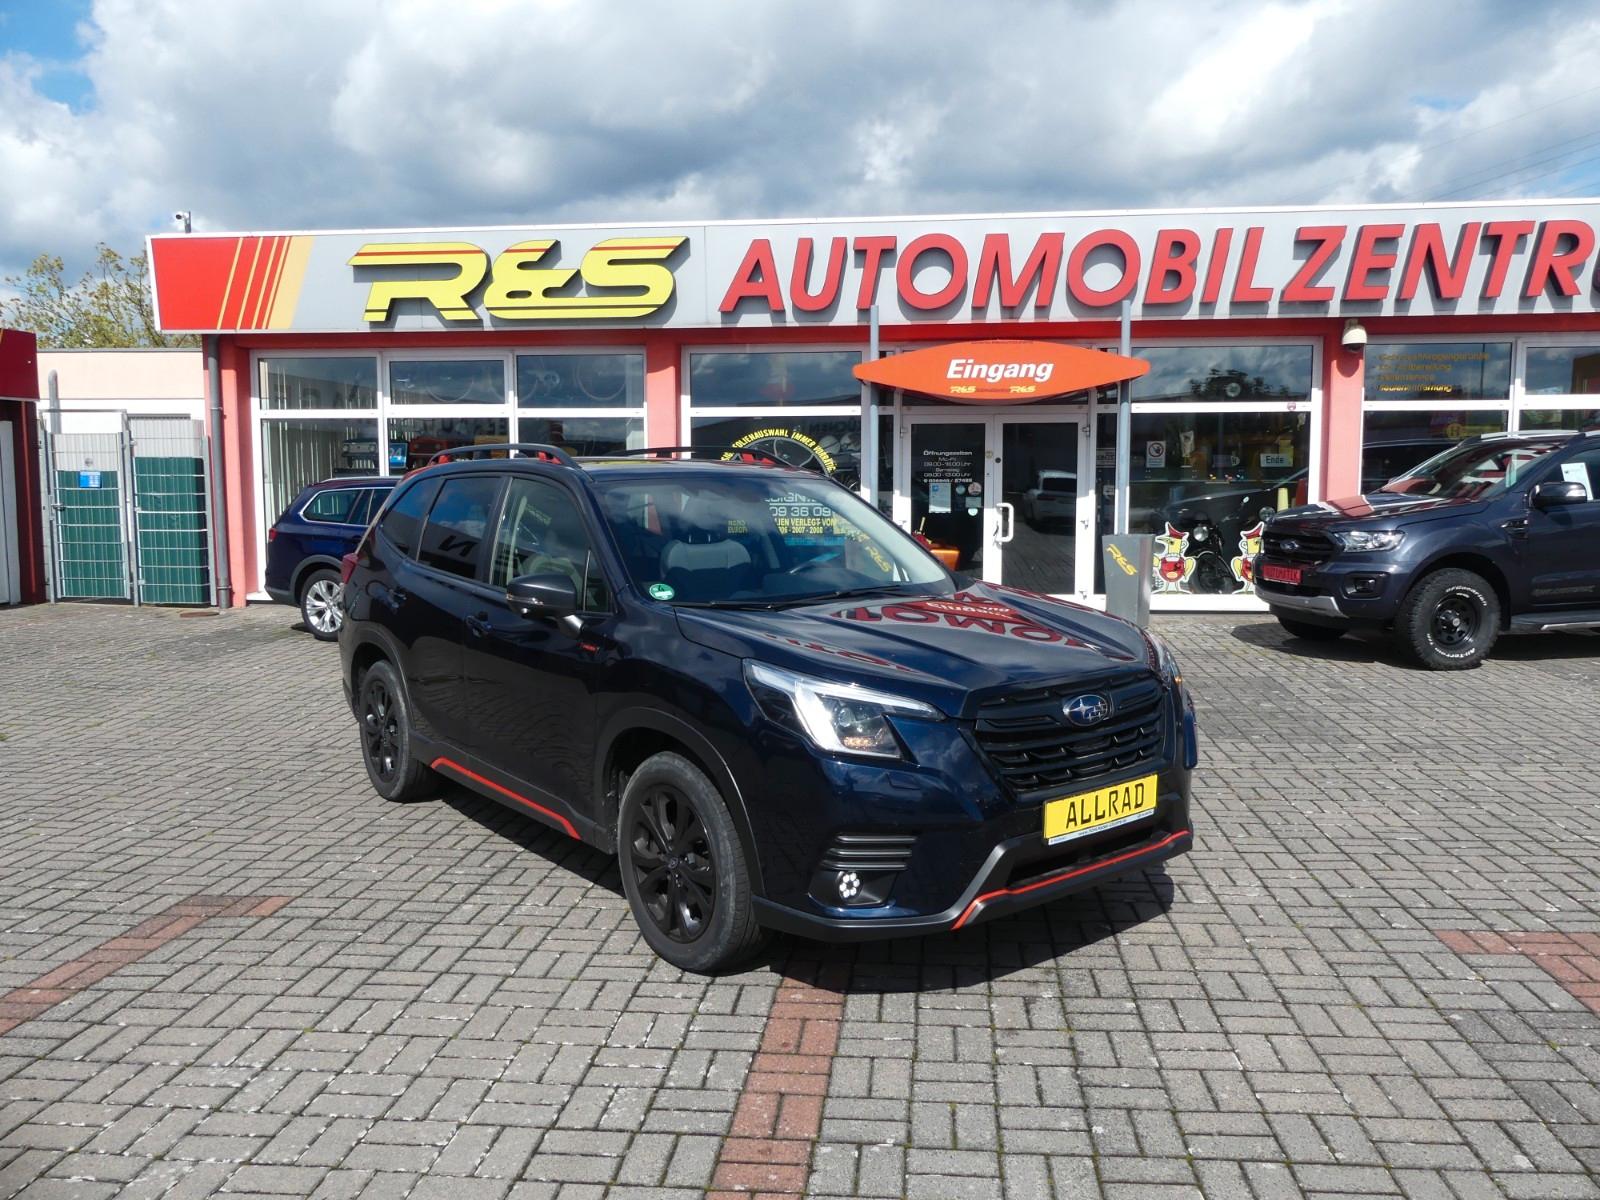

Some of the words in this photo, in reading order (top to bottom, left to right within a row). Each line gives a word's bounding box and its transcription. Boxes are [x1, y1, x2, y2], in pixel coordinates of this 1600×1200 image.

[346, 236, 689, 322] R&S
[718, 219, 1600, 314] AUTOMOBILZENTR
[946, 358, 1054, 383] Eingang
[790, 431, 817, 448] IMMER
[1105, 543, 1138, 576] R&S
[1066, 782, 1145, 829] ALLRAD
